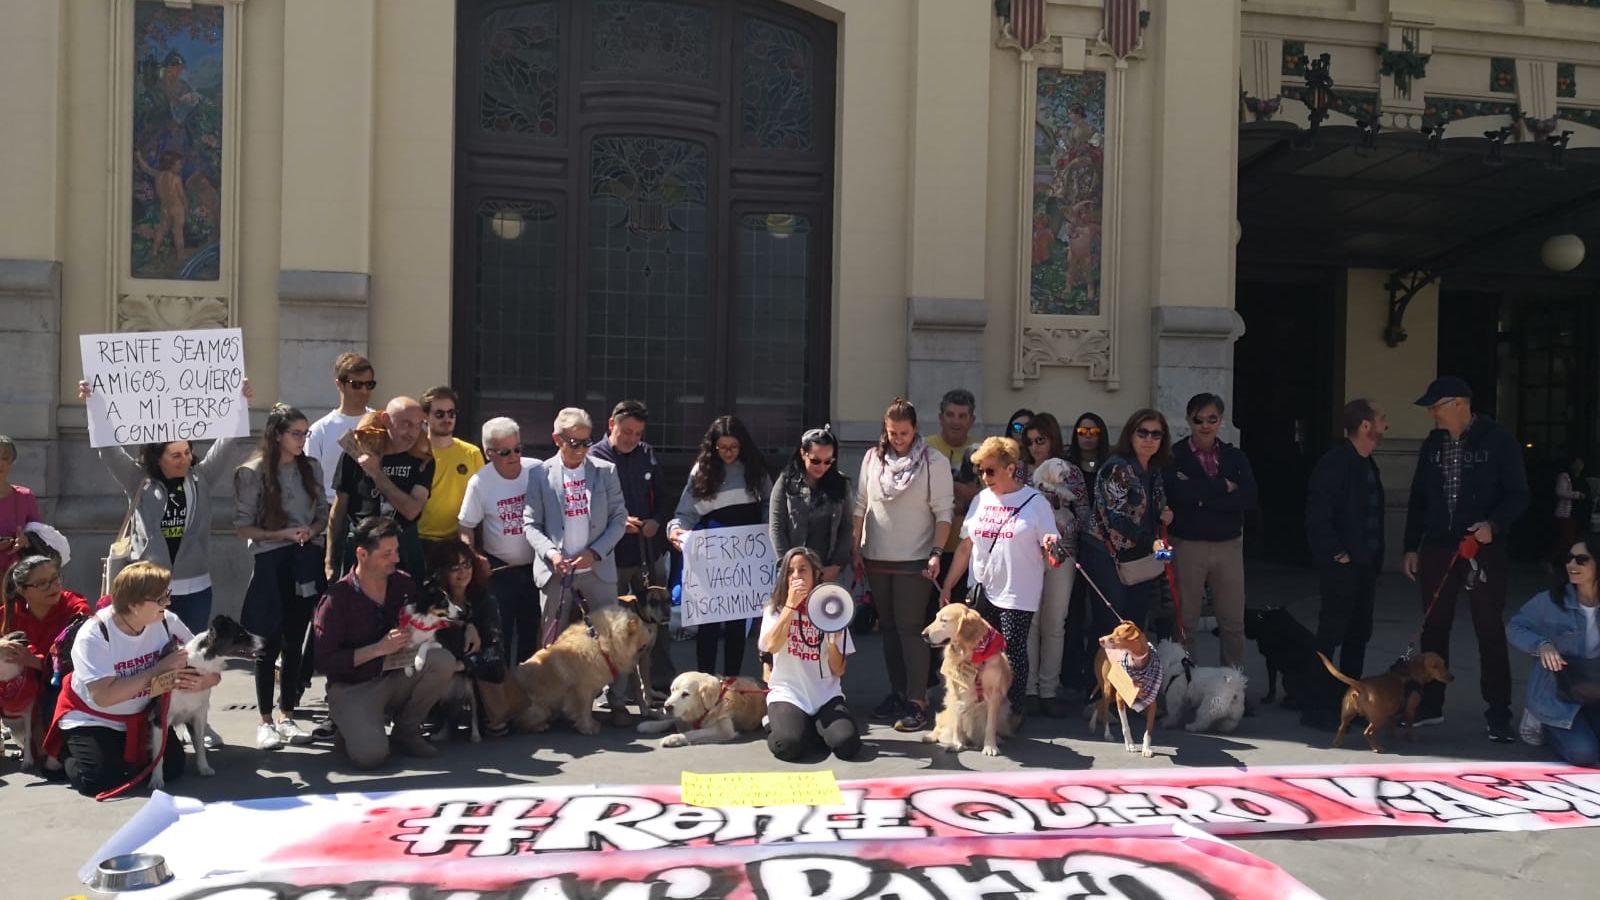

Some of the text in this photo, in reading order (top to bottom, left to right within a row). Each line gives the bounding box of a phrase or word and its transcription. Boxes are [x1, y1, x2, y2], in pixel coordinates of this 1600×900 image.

[97, 335, 239, 364] RENFE SEAMOS
[179, 365, 242, 394] QUIERO
[106, 394, 235, 420] A MI PERRO
[114, 420, 213, 444] CONMIGO
[695, 533, 766, 561] PERROS
[705, 562, 752, 590] VAGÓN
